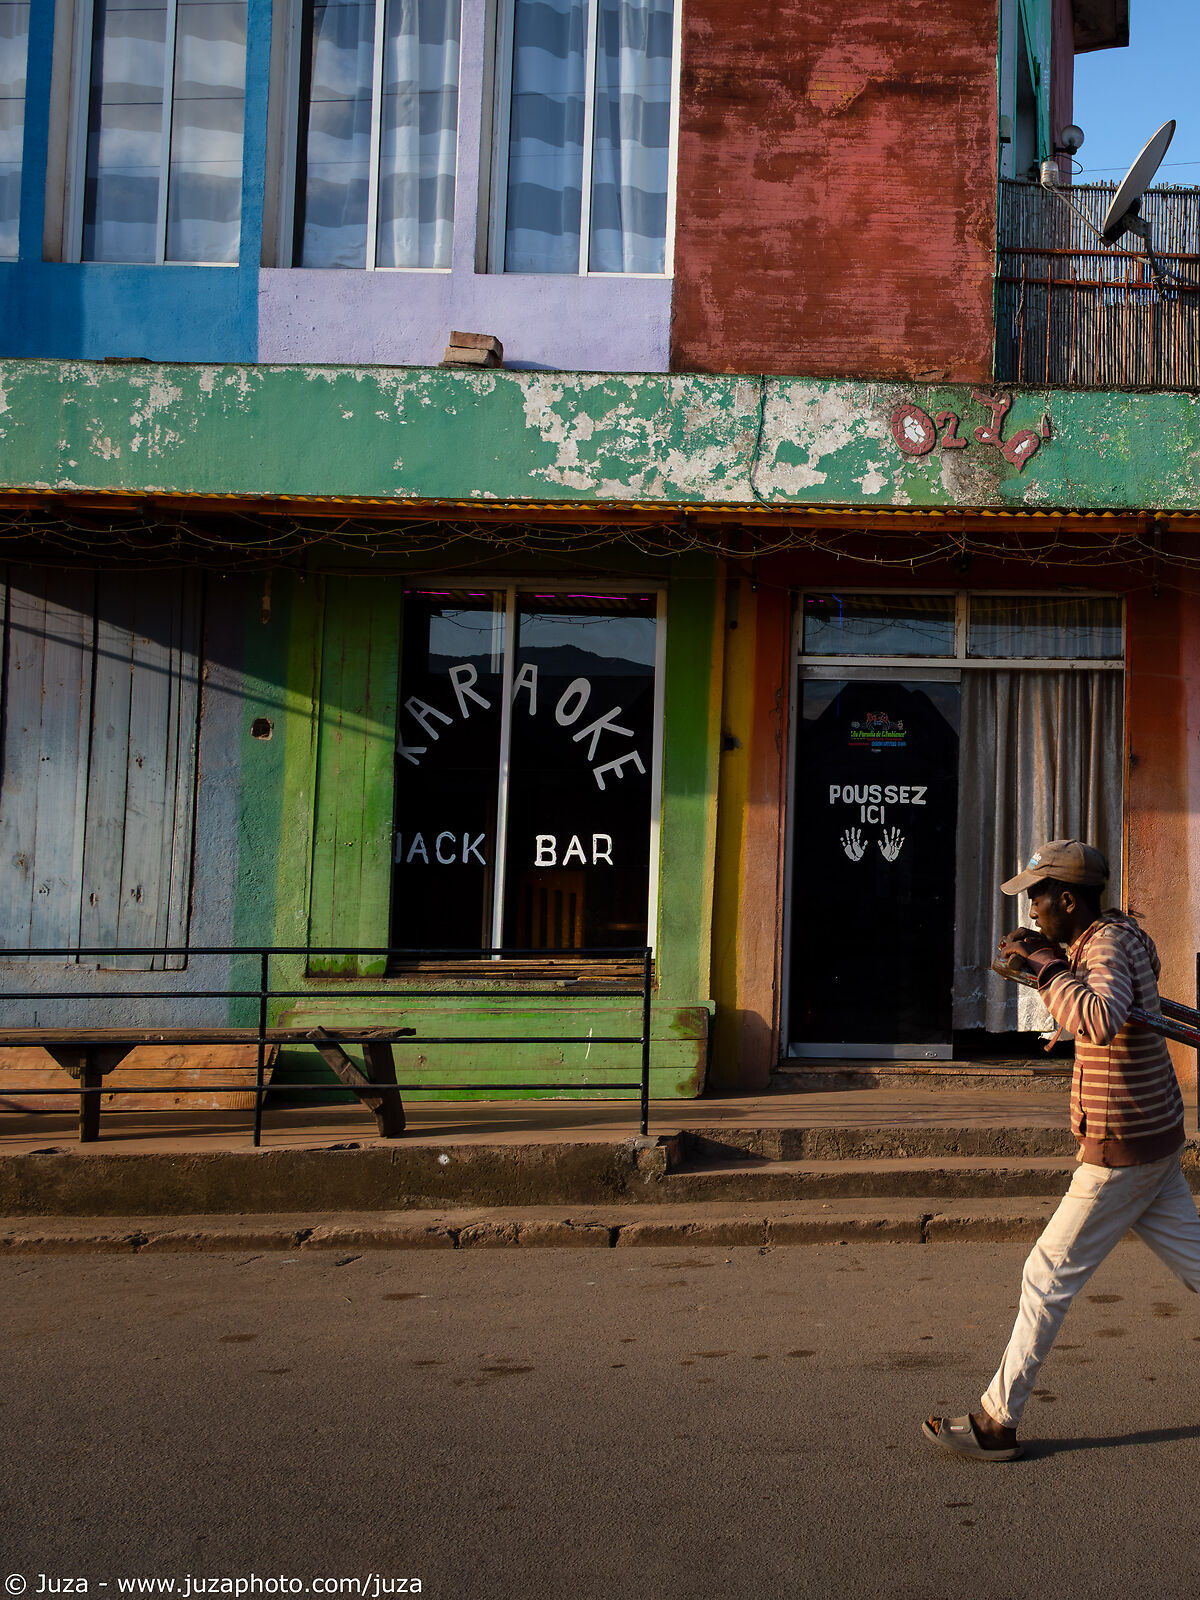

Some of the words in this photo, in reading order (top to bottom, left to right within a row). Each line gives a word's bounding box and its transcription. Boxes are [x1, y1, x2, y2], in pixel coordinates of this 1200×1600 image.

[829, 784, 928, 805] POUSSEZ
[860, 804, 885, 825] ICI
[534, 833, 615, 867] BAR
